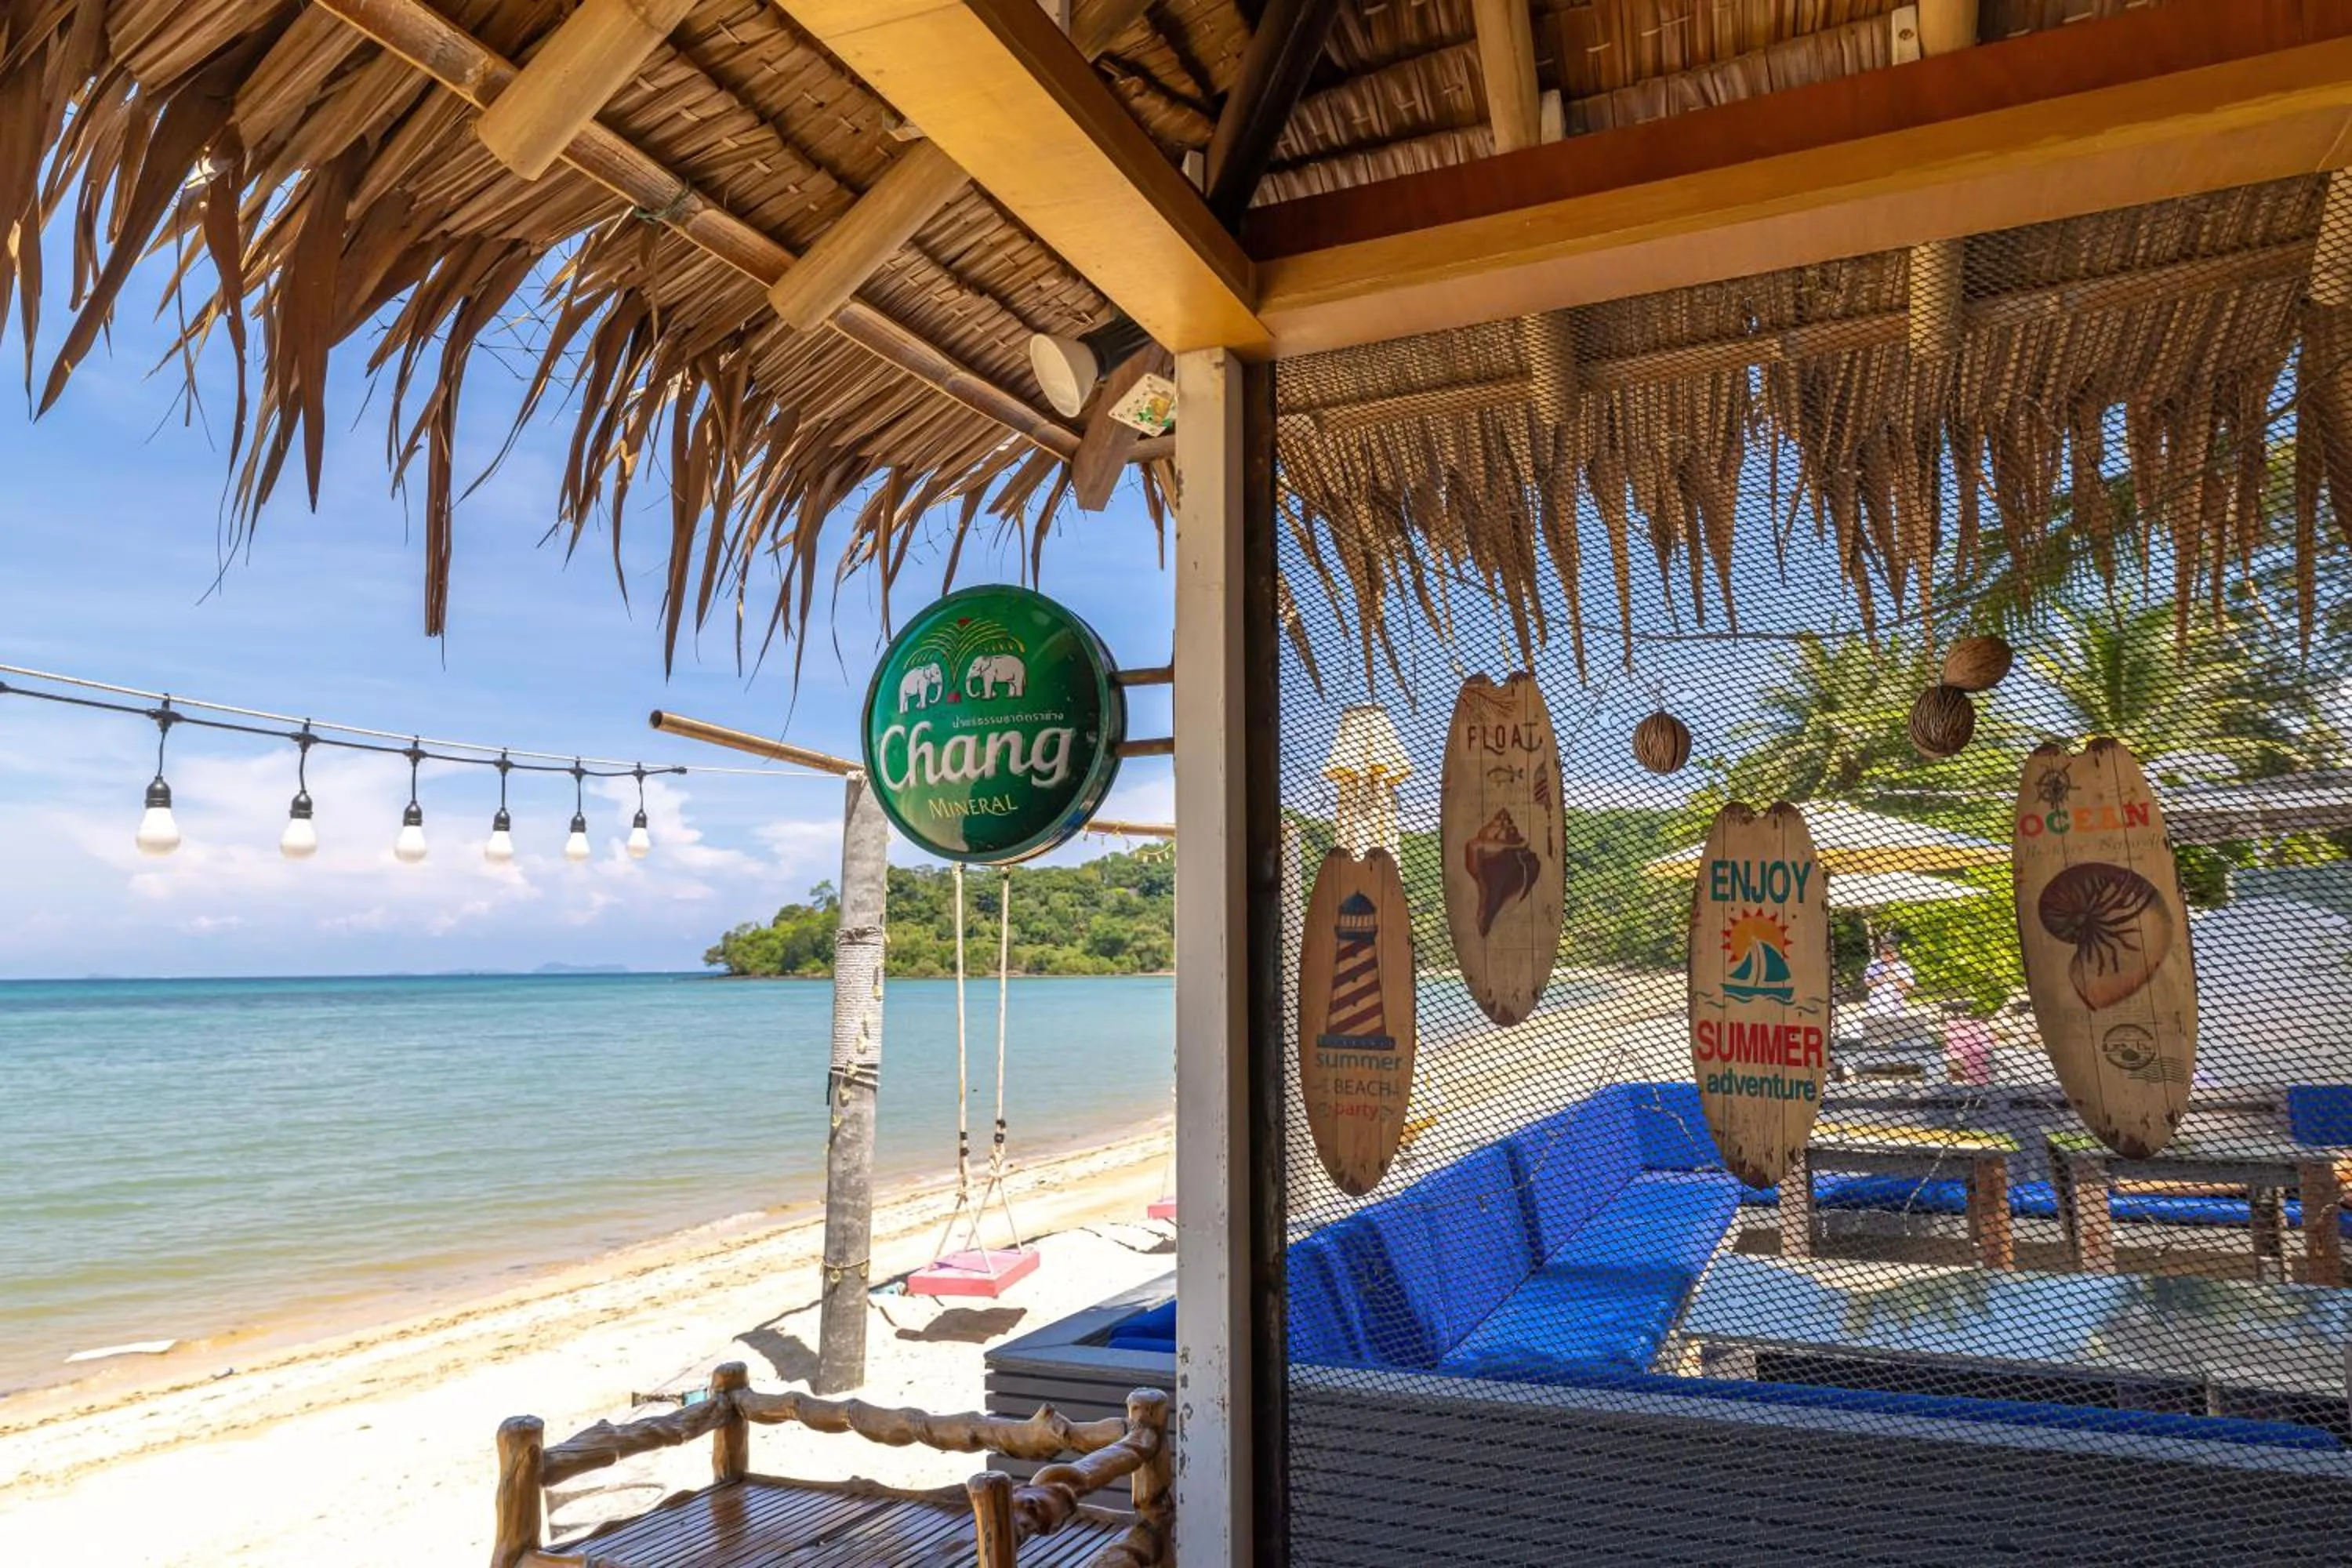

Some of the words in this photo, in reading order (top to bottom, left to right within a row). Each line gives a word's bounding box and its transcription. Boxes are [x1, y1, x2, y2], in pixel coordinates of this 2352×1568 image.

[1468, 722, 1543, 755] FLOAT
[879, 720, 1074, 792] Chang
[2019, 802, 2151, 838] OCEAN
[1711, 859, 1813, 904] ENJOY
[1697, 1019, 1824, 1069] SUMMER
[1316, 1052, 1403, 1071] summer
[1334, 1078, 1391, 1097] BEACH
[1707, 1068, 1817, 1102] adventure
[1334, 1102, 1379, 1122] party
